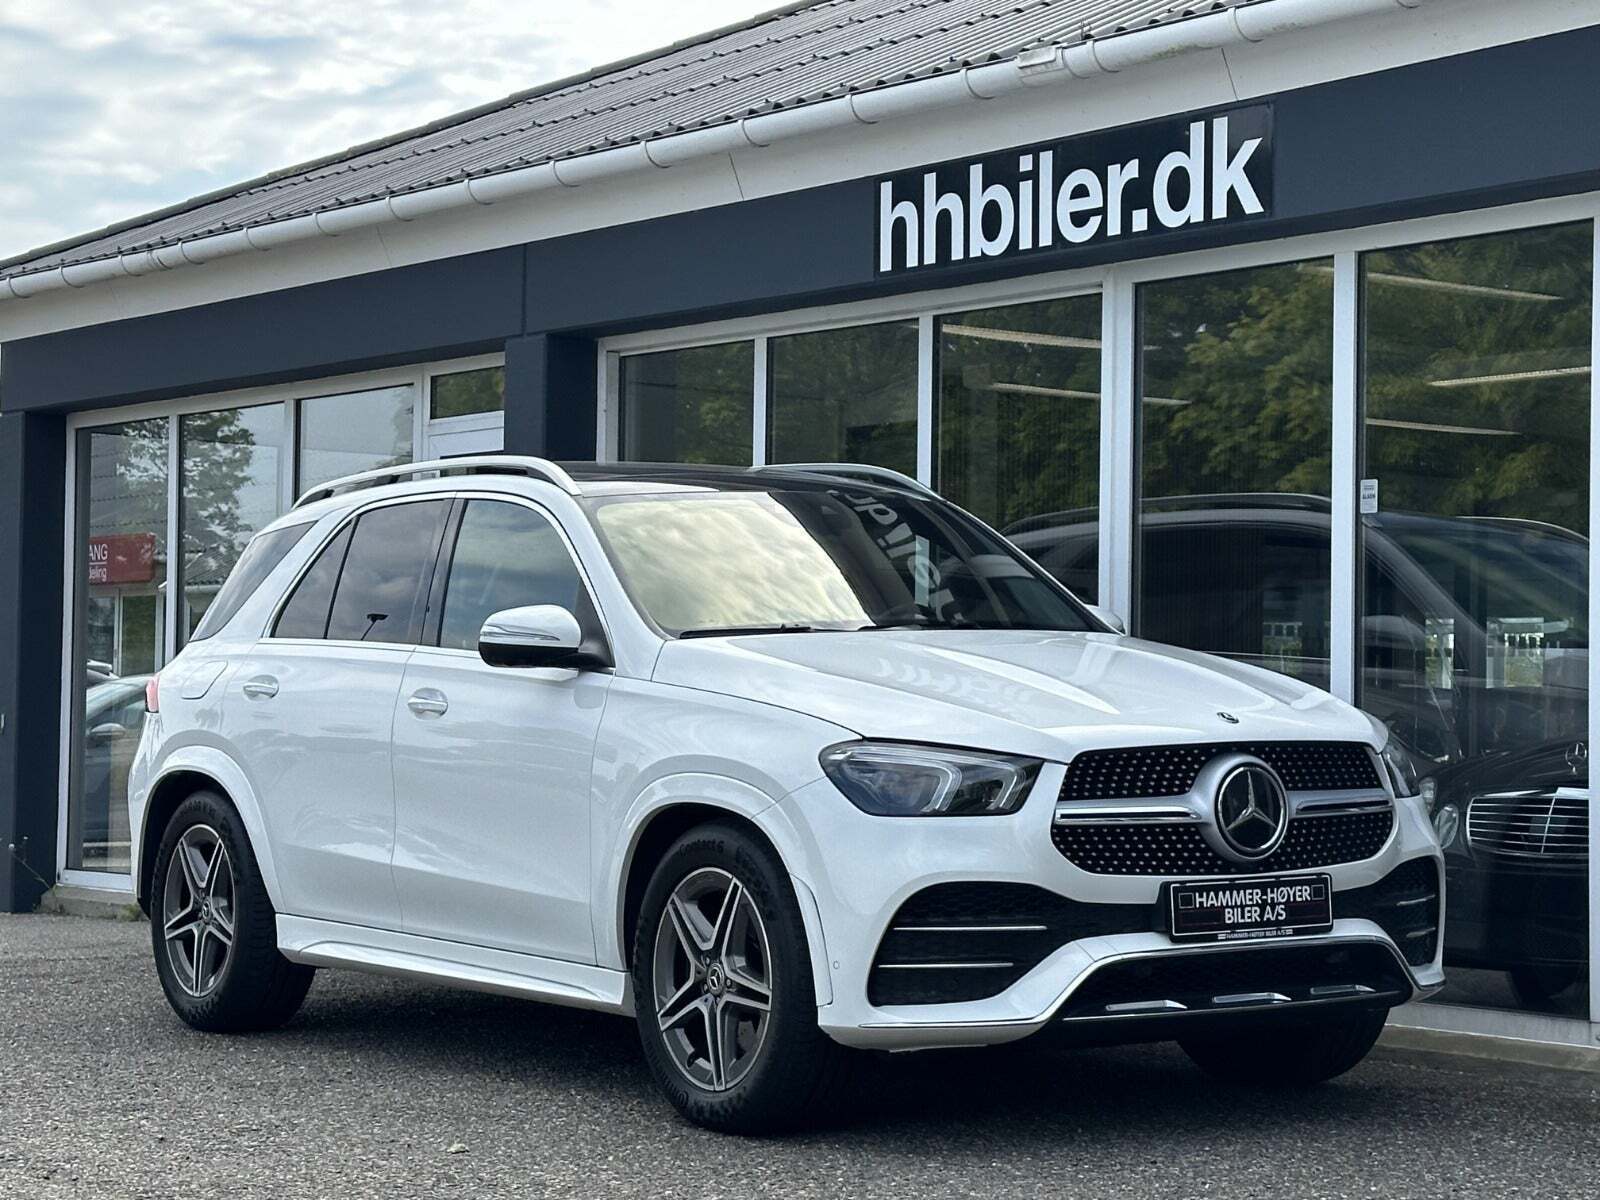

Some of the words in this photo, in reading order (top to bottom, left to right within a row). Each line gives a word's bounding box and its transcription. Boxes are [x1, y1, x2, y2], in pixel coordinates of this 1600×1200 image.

[879, 115, 1265, 273] hhbiler.dk
[1195, 885, 1311, 908] HAMMER-HØYER
[1224, 907, 1261, 924] BILER
[1263, 904, 1286, 922] A/S
